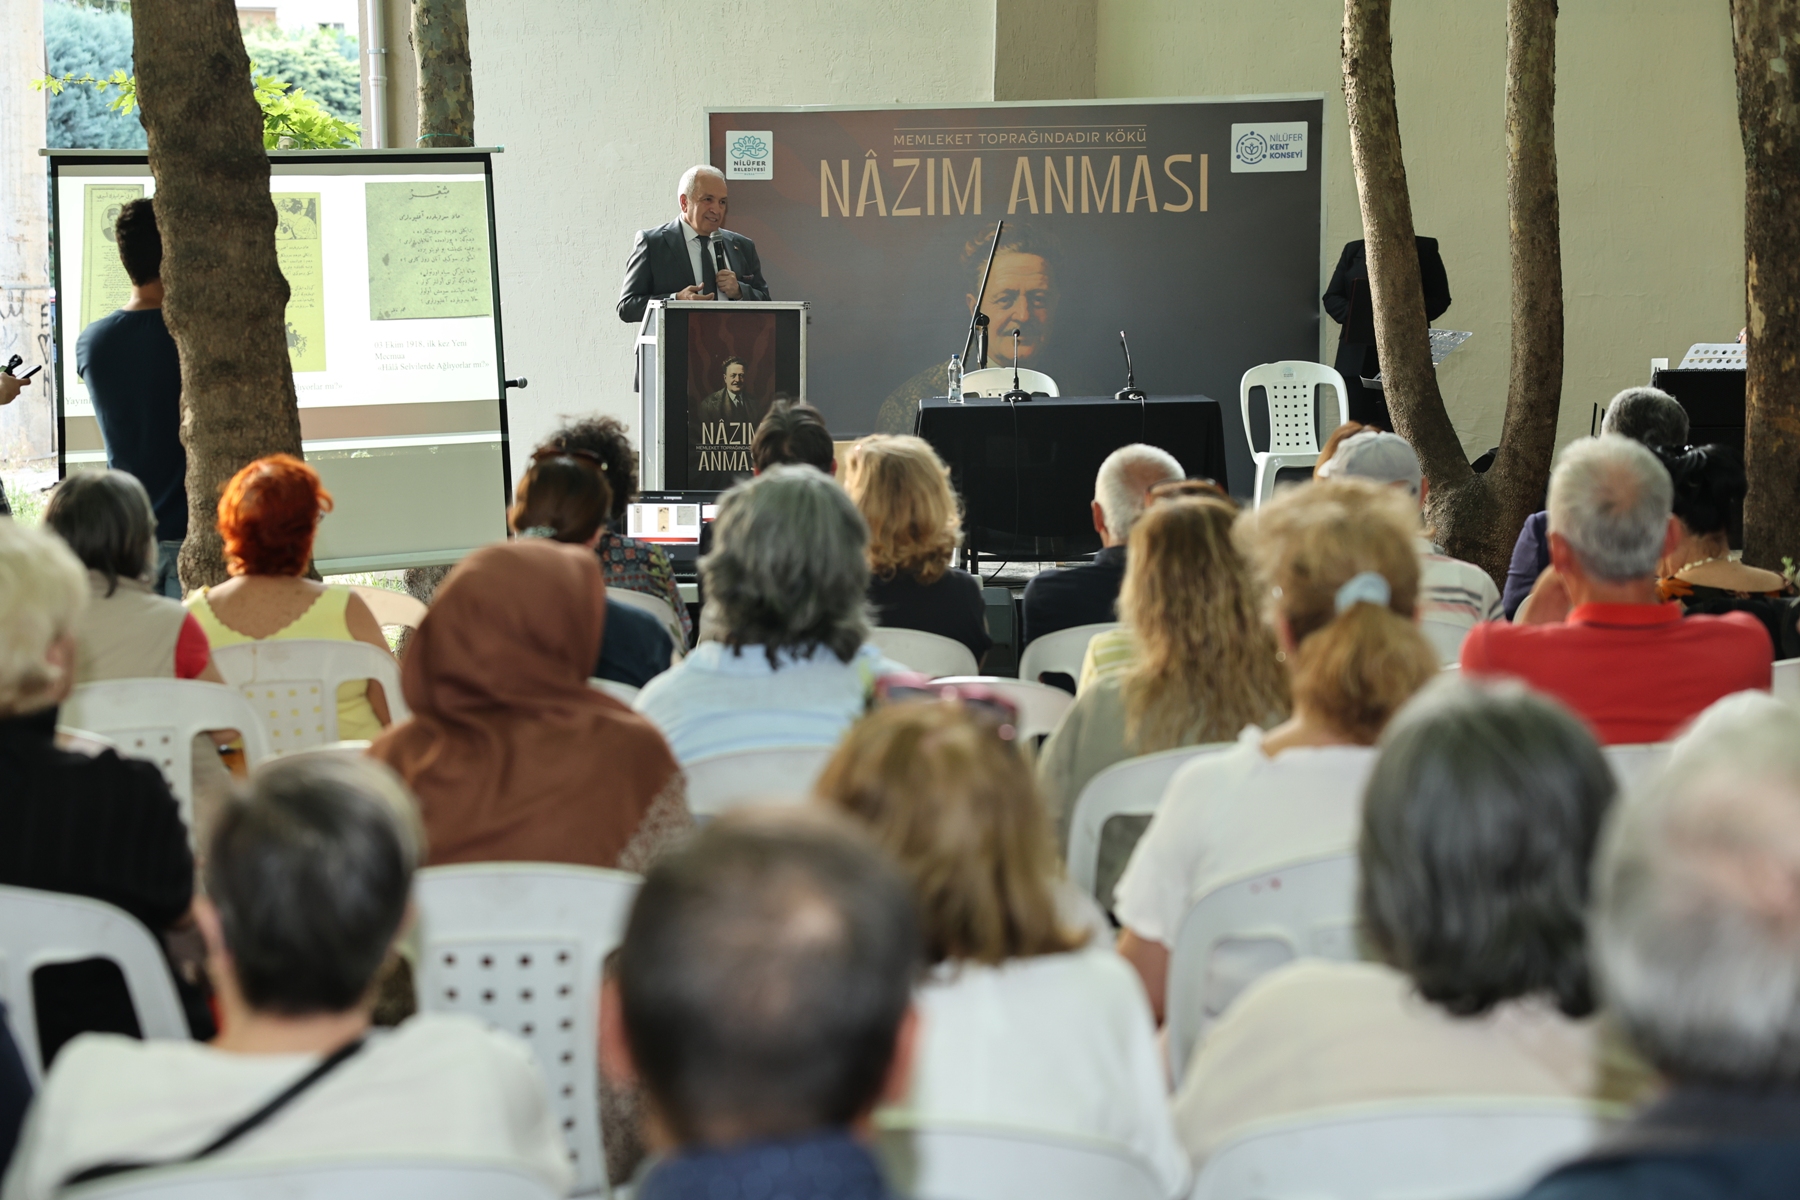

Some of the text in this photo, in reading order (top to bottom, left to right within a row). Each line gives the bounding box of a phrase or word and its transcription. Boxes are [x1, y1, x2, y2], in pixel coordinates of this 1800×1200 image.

[894, 129, 1147, 146] MEMLEKET TOPRAĞINDADIR KÖKÜ
[1269, 133, 1303, 142] NİLÜFER
[1269, 150, 1303, 159] KONSEYİ
[820, 149, 1208, 217] NÂZIM ANMASI
[374, 341, 384, 349] 03
[385, 340, 404, 349] Ekim
[427, 339, 436, 348] ilk
[438, 339, 450, 348] kez
[451, 338, 467, 347] Yeni
[400, 362, 435, 371] Selvilerde
[437, 361, 471, 371] Ağlıyorlar
[296, 382, 323, 393] lıyorlar
[698, 451, 755, 471] ANMA
